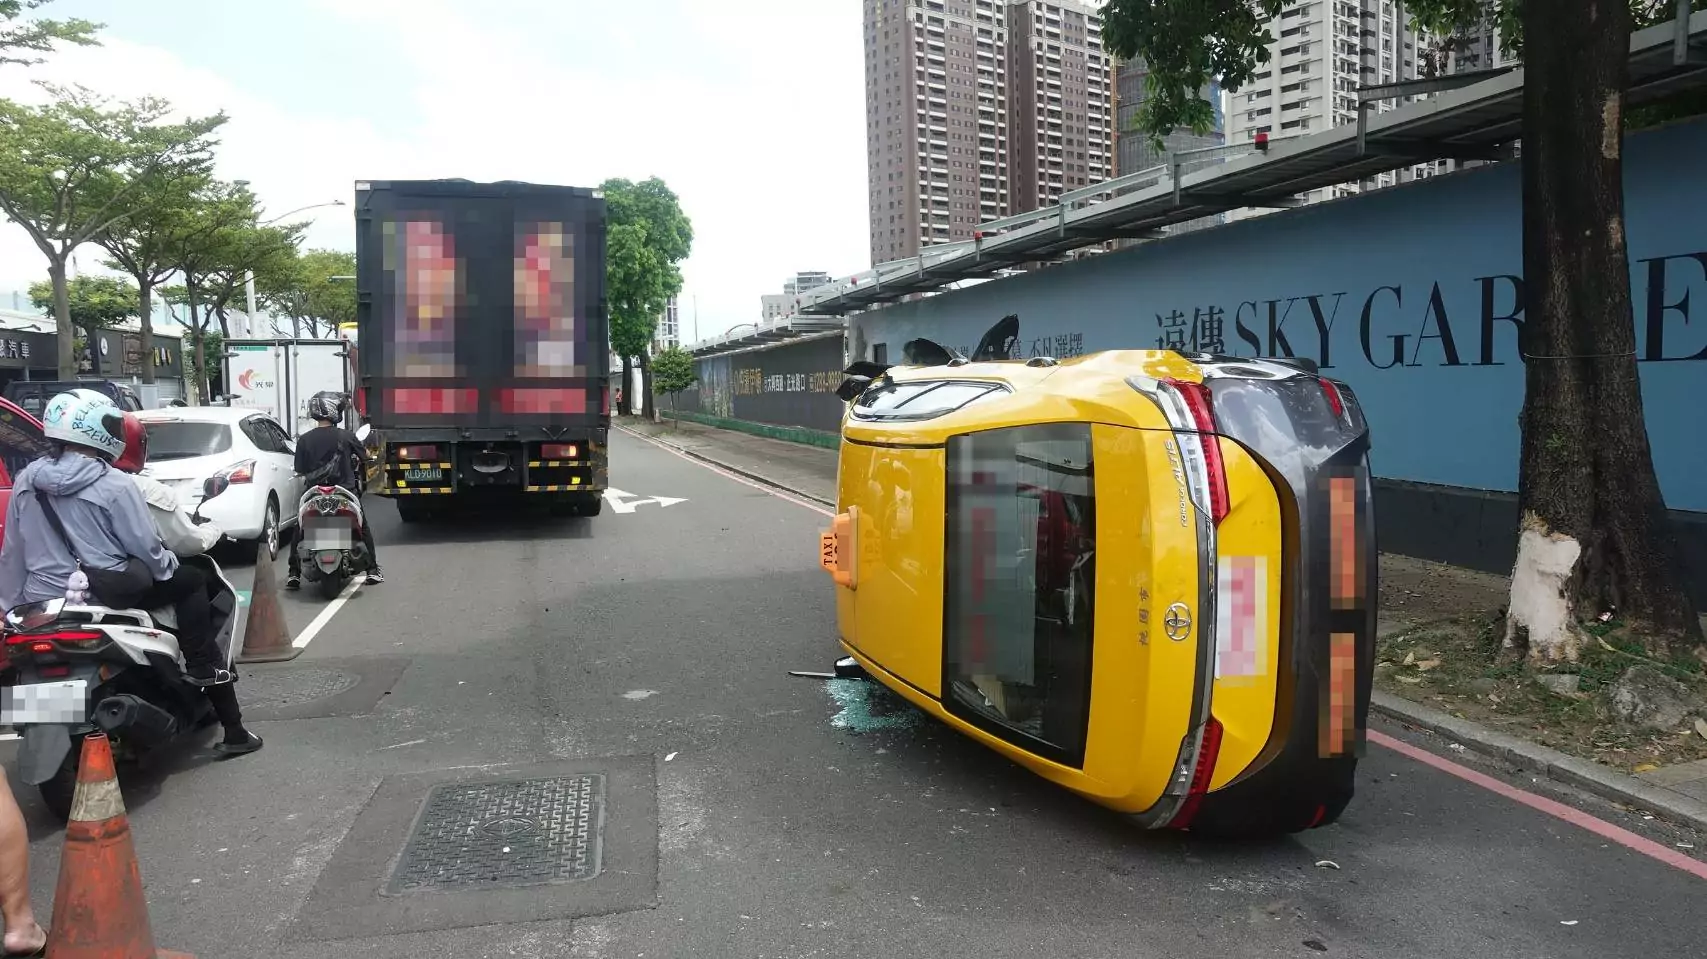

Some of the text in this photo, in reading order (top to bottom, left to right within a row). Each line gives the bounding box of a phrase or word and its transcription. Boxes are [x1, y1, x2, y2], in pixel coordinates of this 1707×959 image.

[1236, 292, 1349, 369] SKY
[1360, 252, 1707, 370] GARE
[1164, 439, 1186, 485] ALTIS
[823, 536, 833, 566] TAXI
